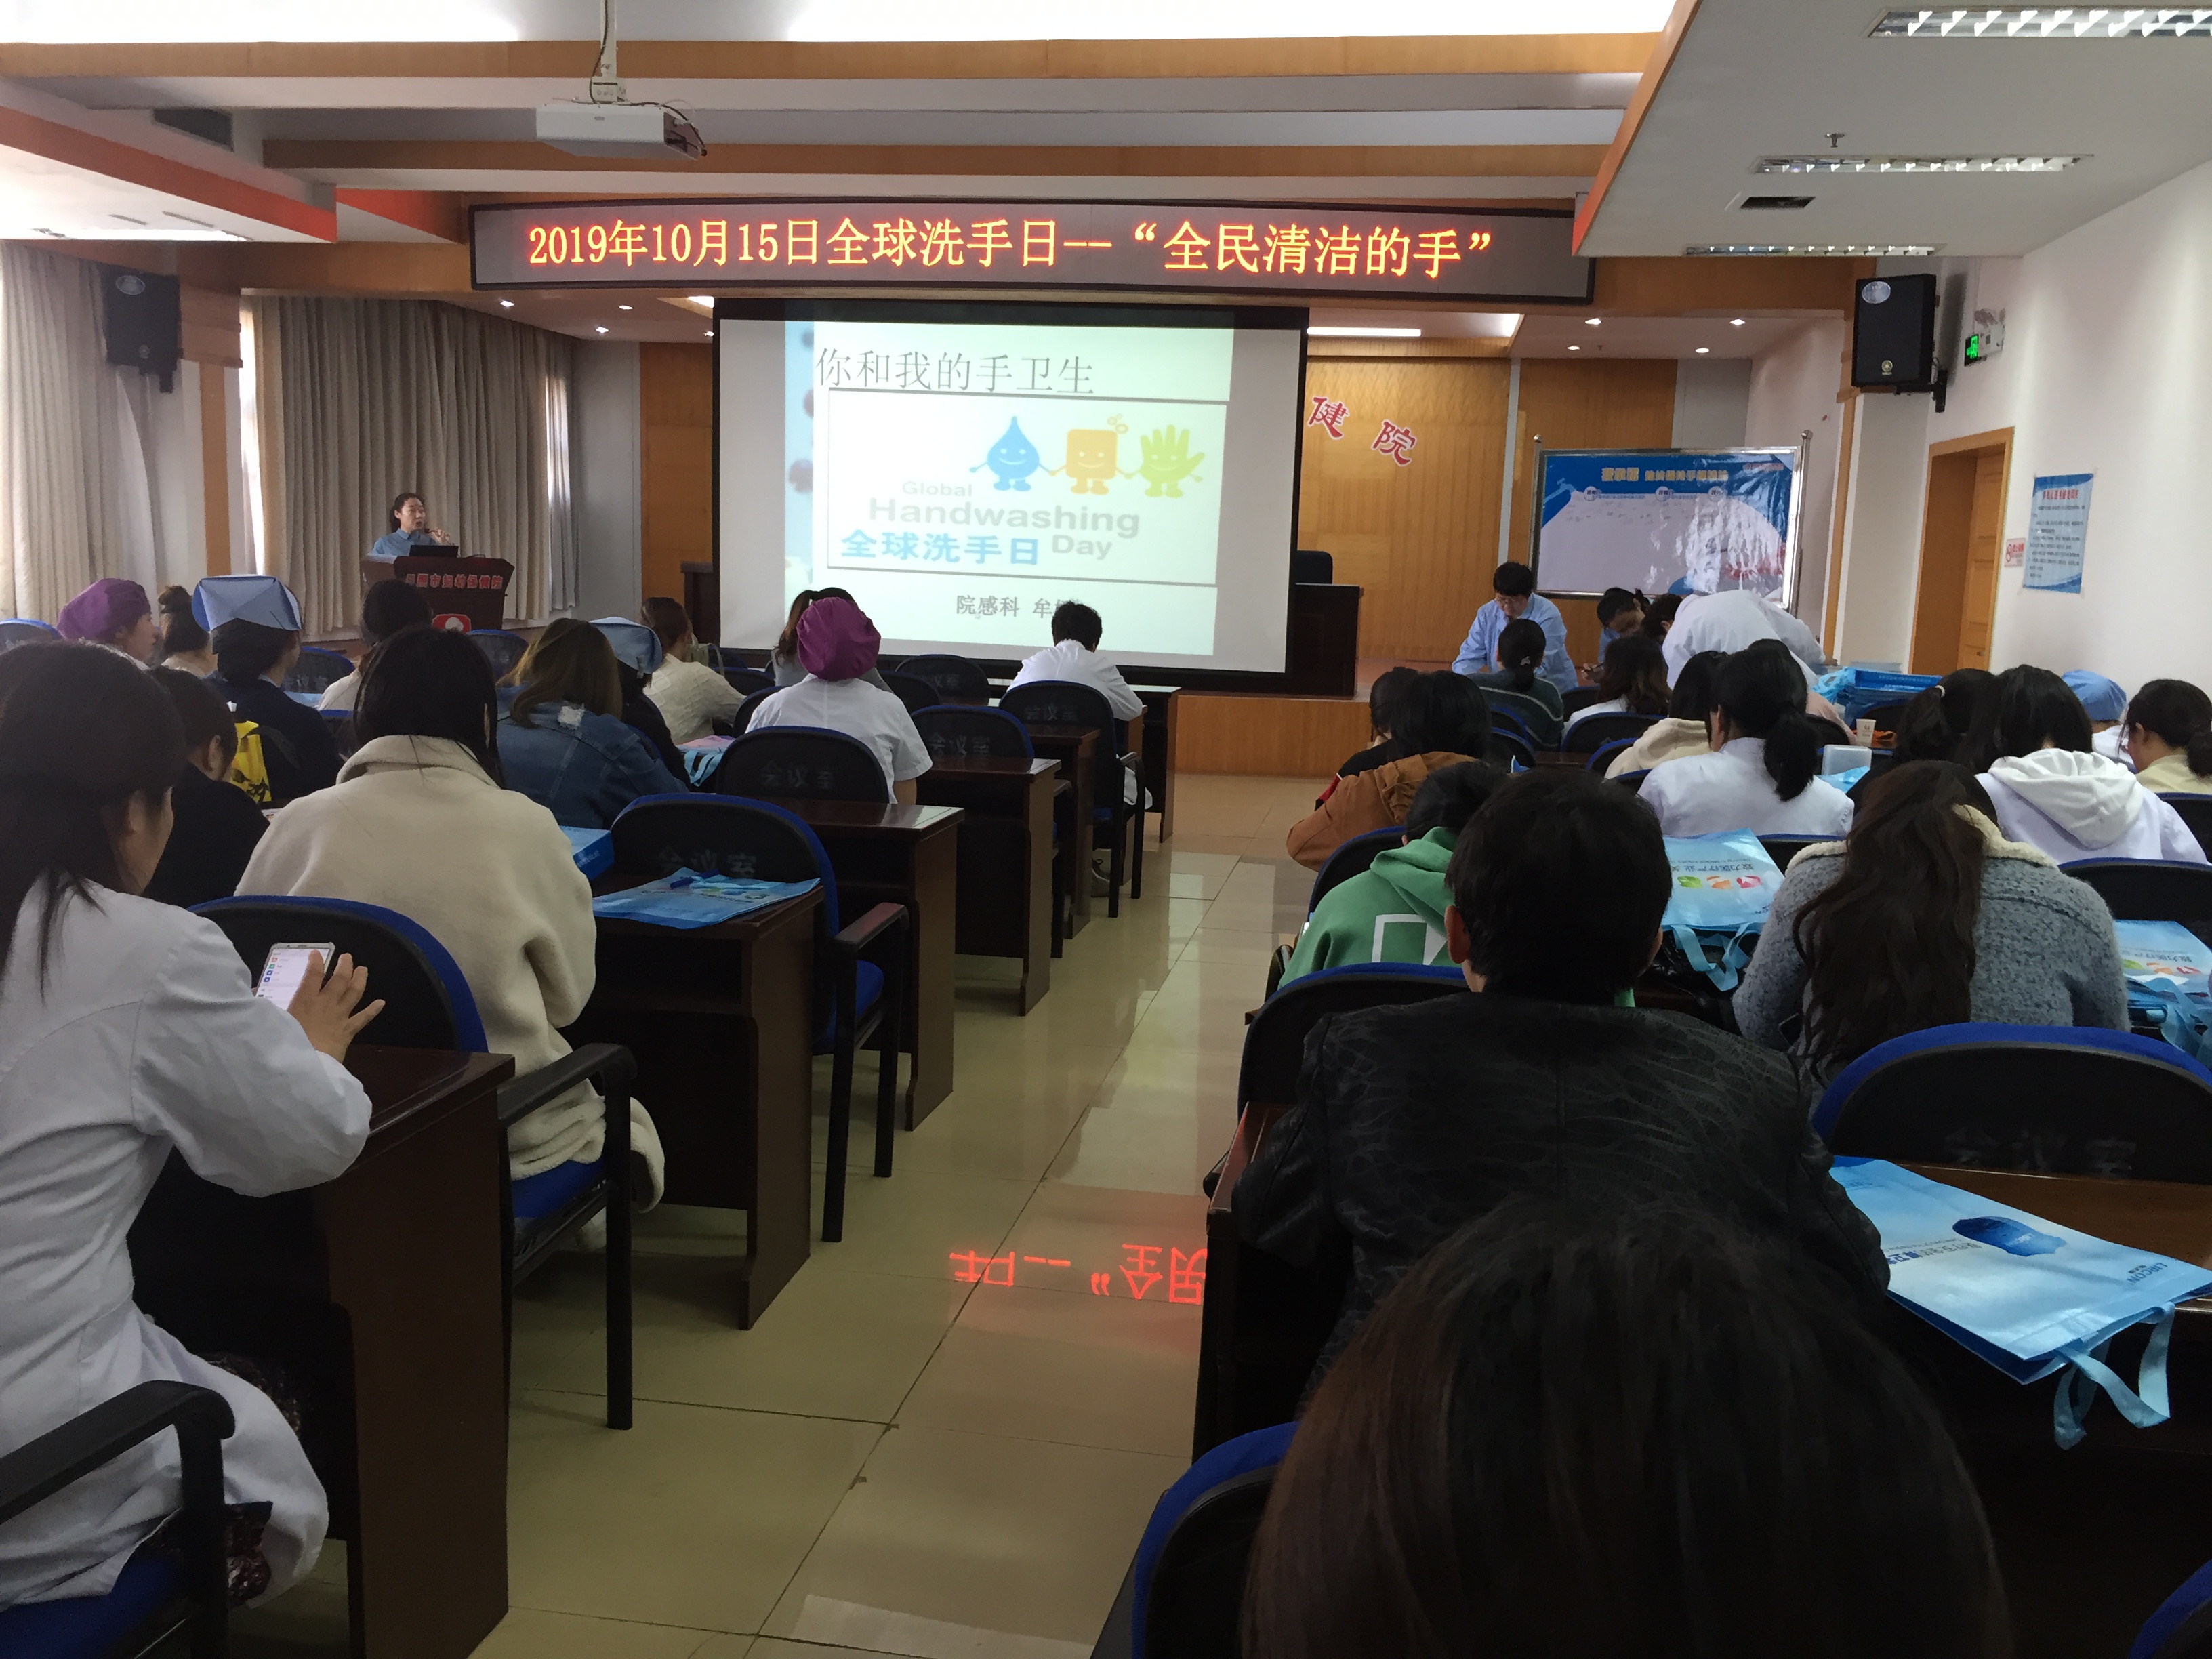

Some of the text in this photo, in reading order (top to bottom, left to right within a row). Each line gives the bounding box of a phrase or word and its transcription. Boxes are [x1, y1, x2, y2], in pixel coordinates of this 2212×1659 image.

[815, 348, 1095, 395] 你和我的手卫生
[902, 480, 972, 497] Global
[869, 497, 1139, 539] Handwashing
[841, 529, 1039, 565] 全球洗手日
[1052, 534, 1113, 560] Day
[956, 595, 1020, 617] 院感科
